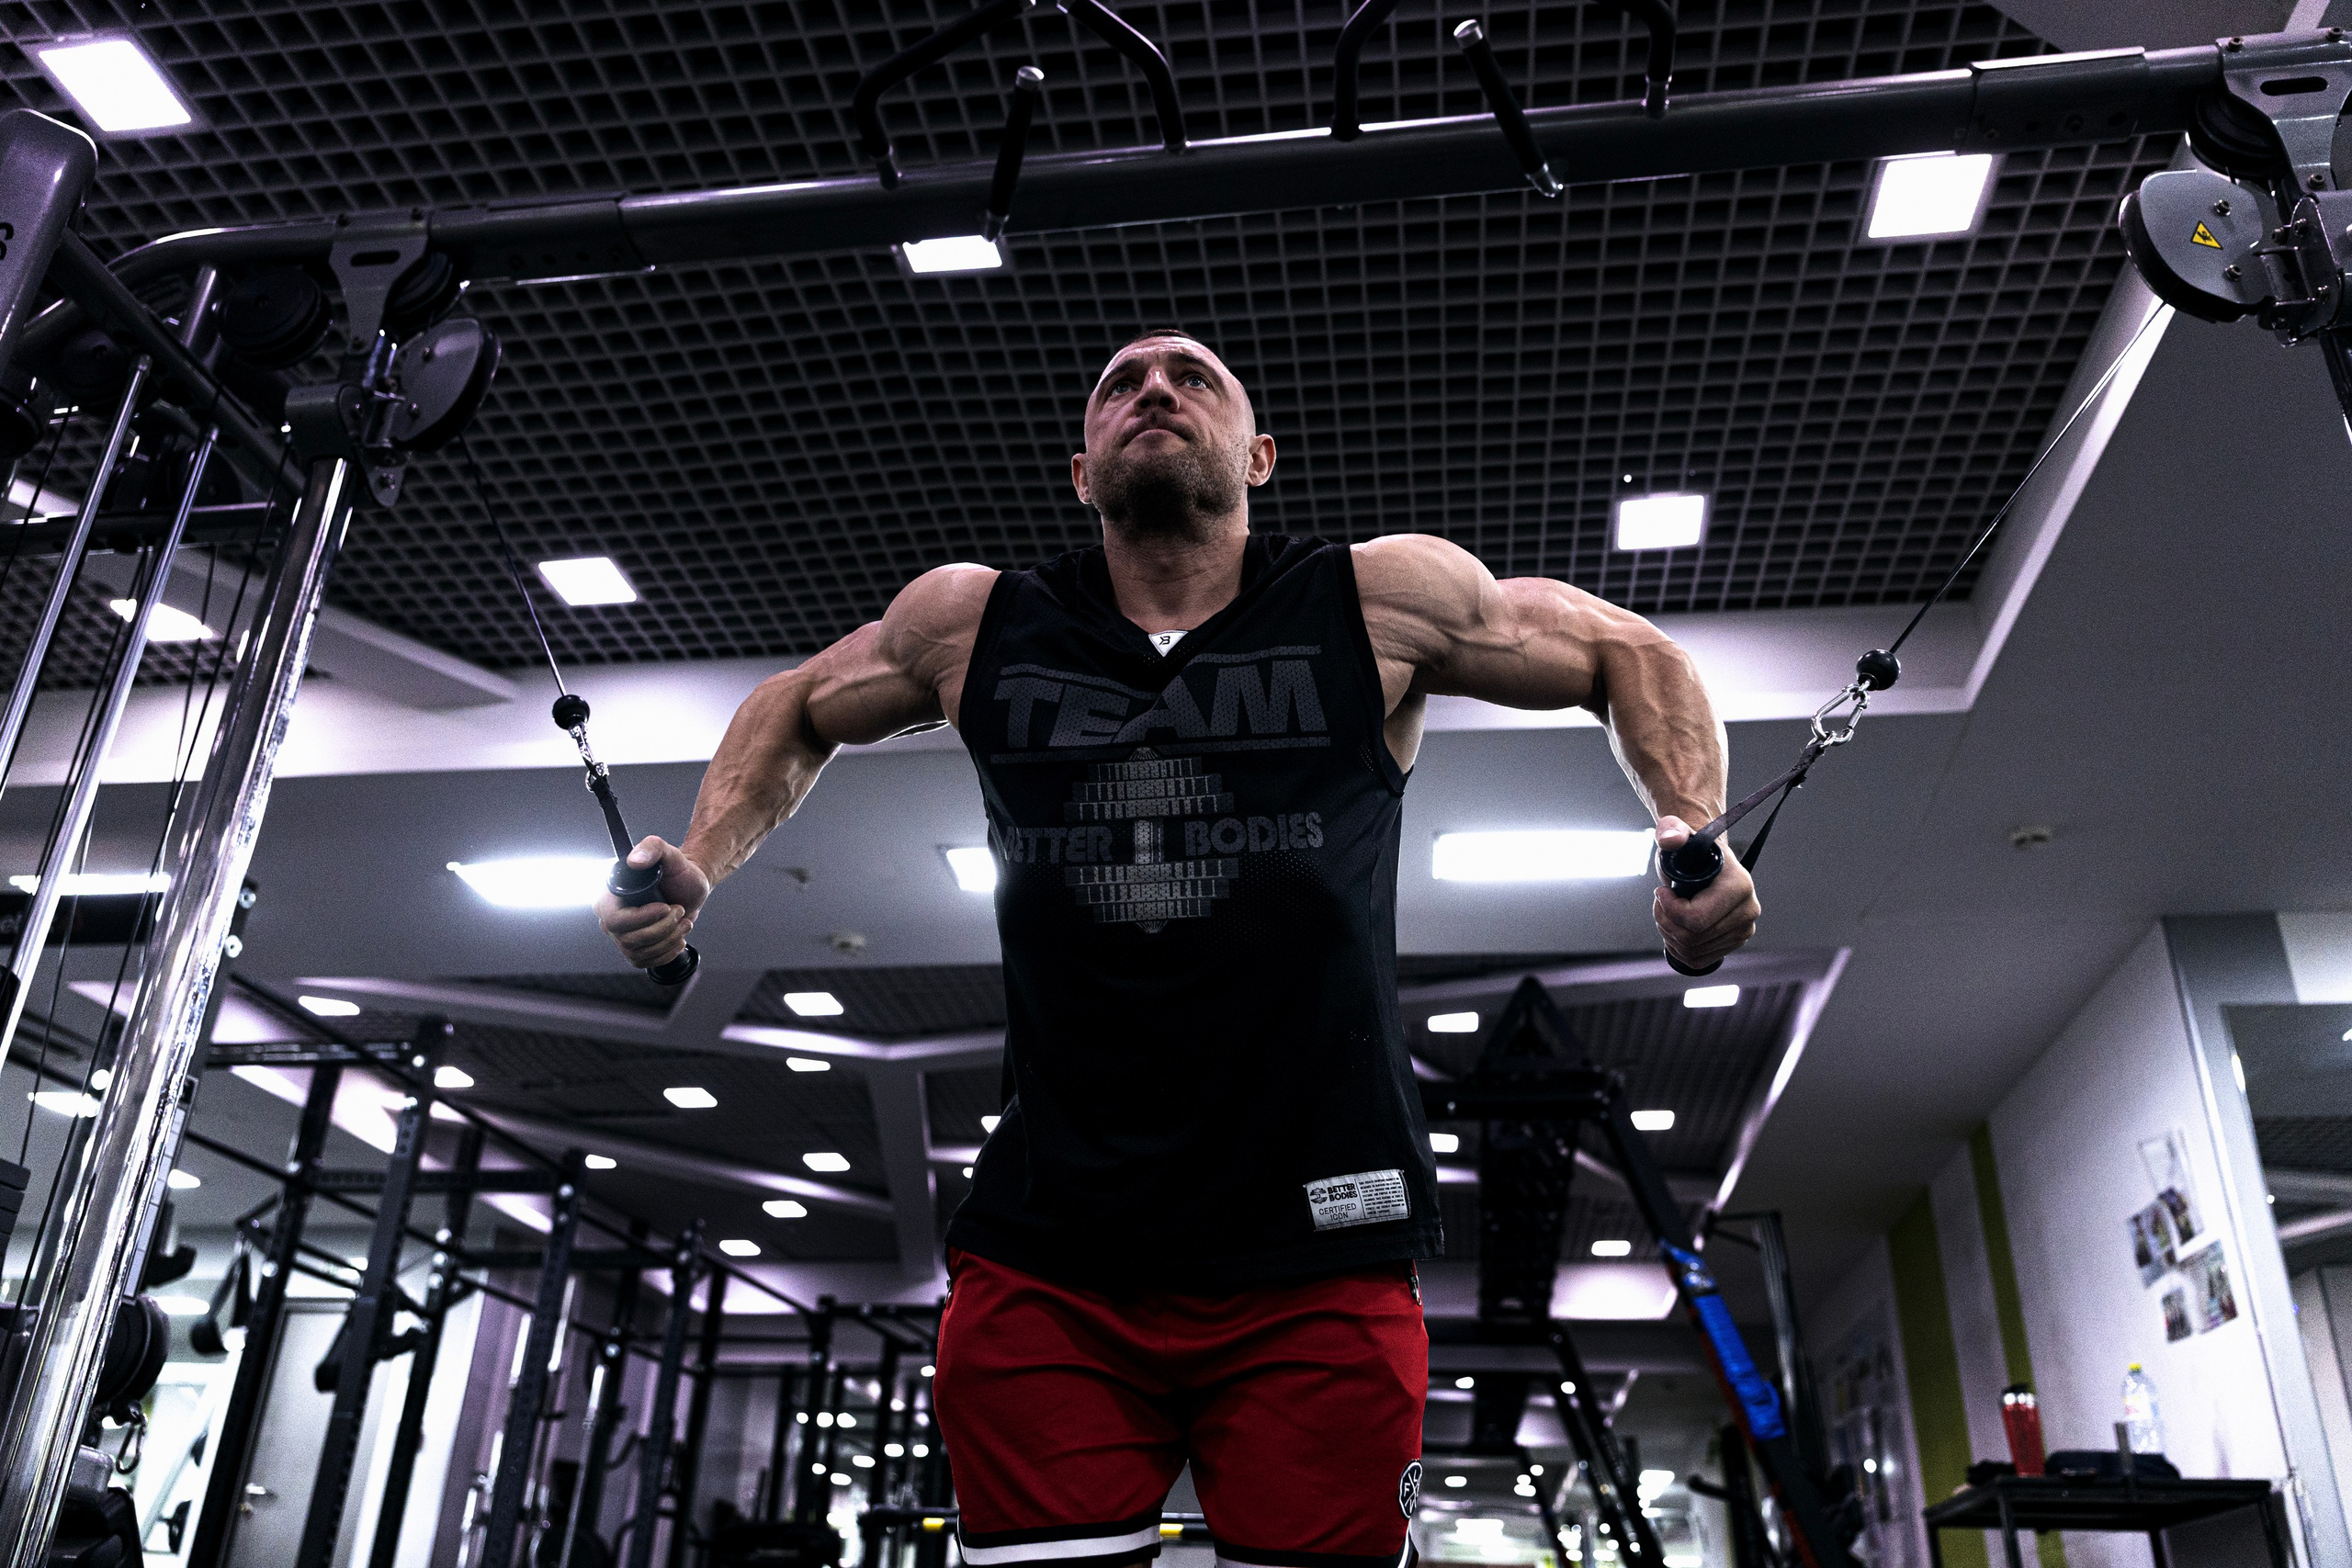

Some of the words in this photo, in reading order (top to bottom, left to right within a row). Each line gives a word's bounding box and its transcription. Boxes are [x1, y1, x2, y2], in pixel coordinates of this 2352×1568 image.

[994, 659, 1329, 749] TEAM
[1184, 812, 1324, 856] BODIES
[1328, 1183, 1355, 1194] BETTER
[1329, 1191, 1358, 1201] BODIES
[1319, 1203, 1356, 1215] CERTIFIED
[1330, 1212, 1349, 1221] ICON
